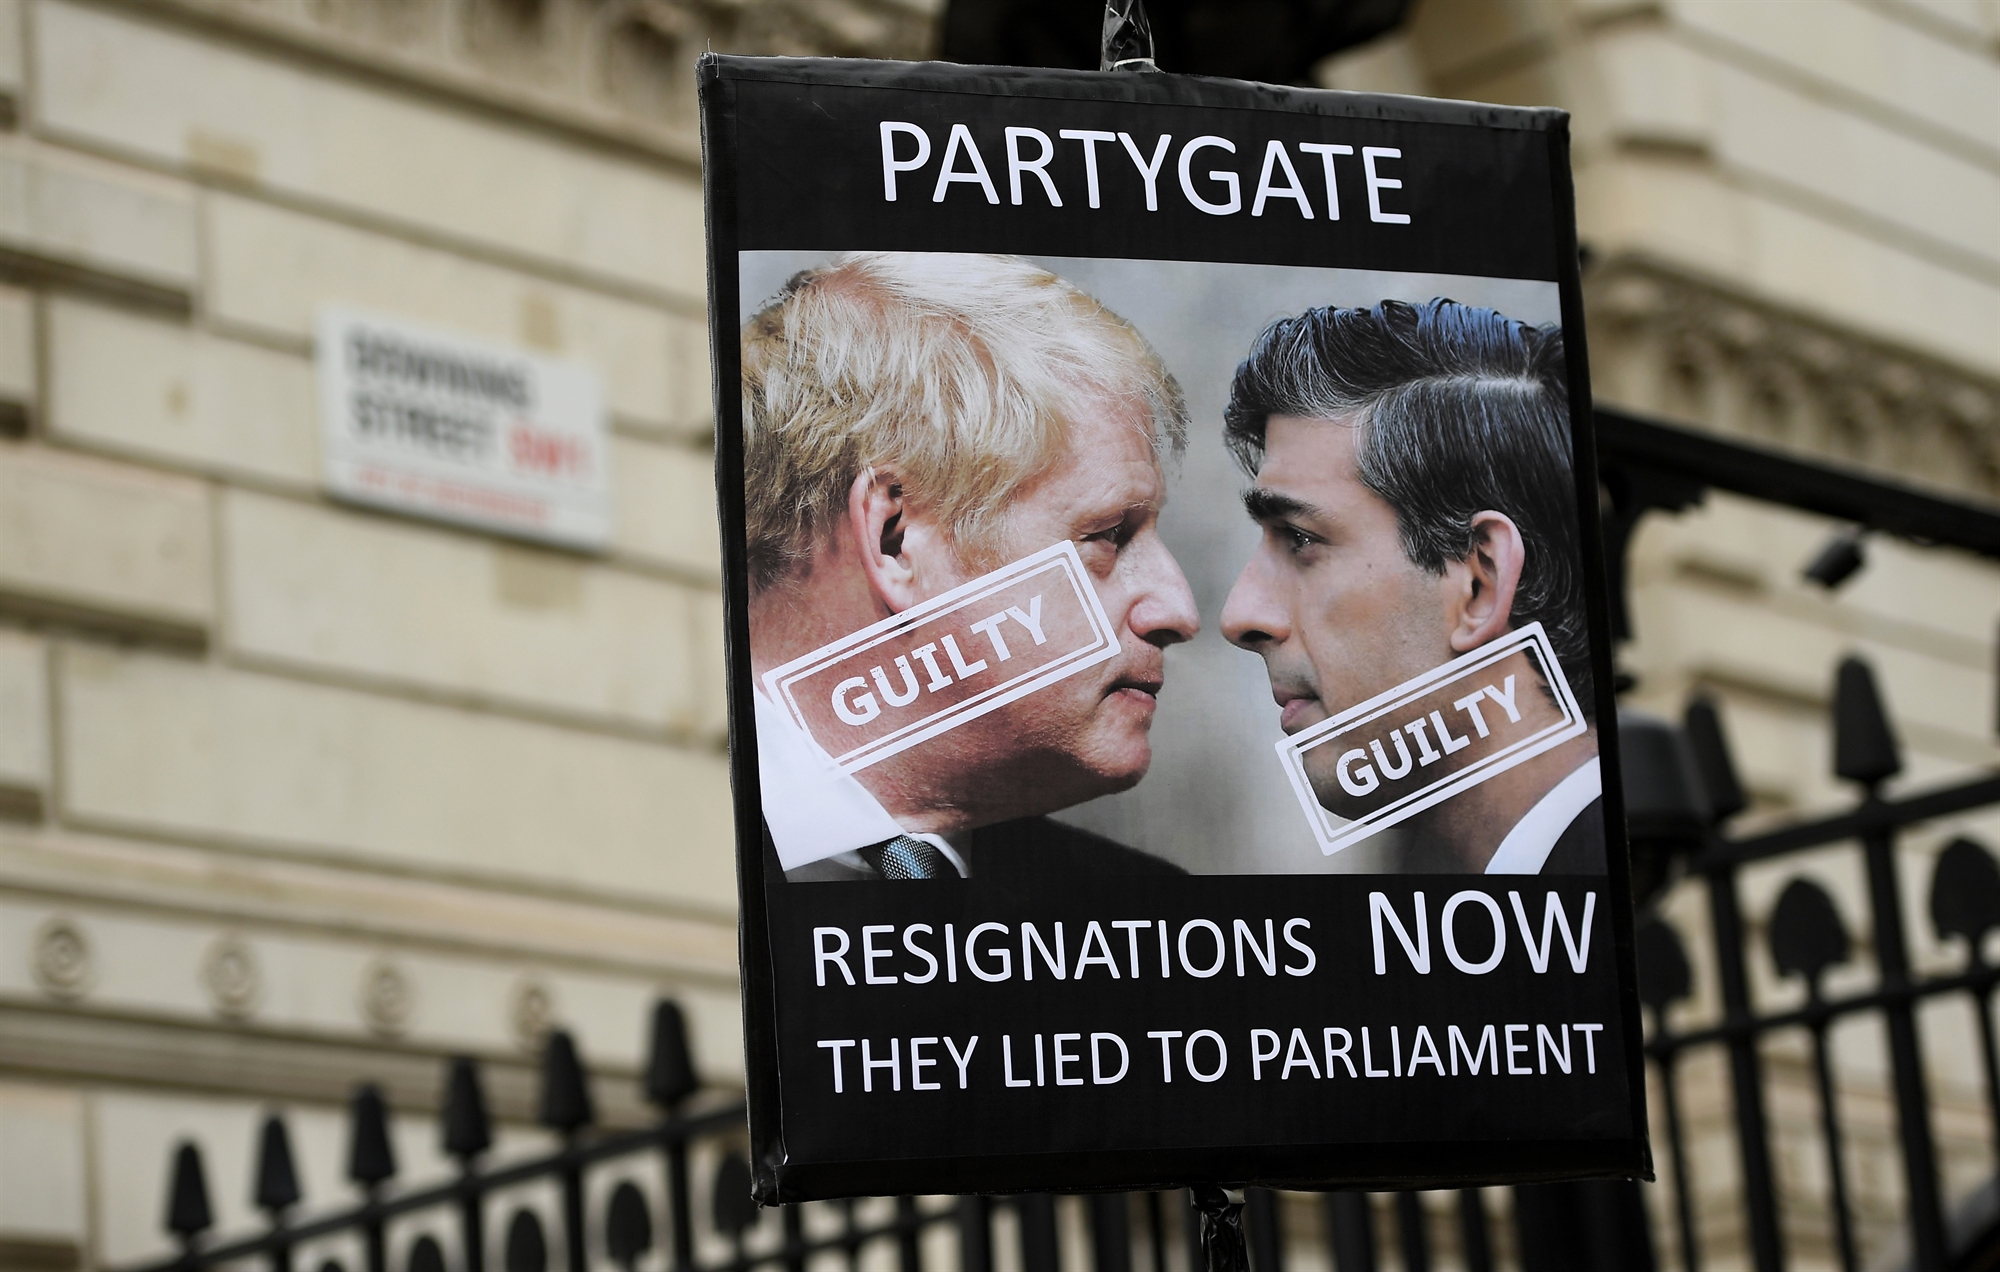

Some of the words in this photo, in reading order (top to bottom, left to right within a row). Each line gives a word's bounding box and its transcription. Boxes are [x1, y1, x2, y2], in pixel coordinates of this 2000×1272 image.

[879, 121, 1411, 225] PARTYGATE
[831, 594, 1047, 726] GUILTY
[1336, 673, 1522, 797] GUILTY
[813, 917, 1317, 987] RESIGNATIONS
[1368, 890, 1597, 975] NOW
[816, 1035, 979, 1094] THEY
[1002, 1032, 1130, 1088] LIED
[1146, 1029, 1228, 1083] TO
[1250, 1023, 1604, 1081] PARLIAMENT
